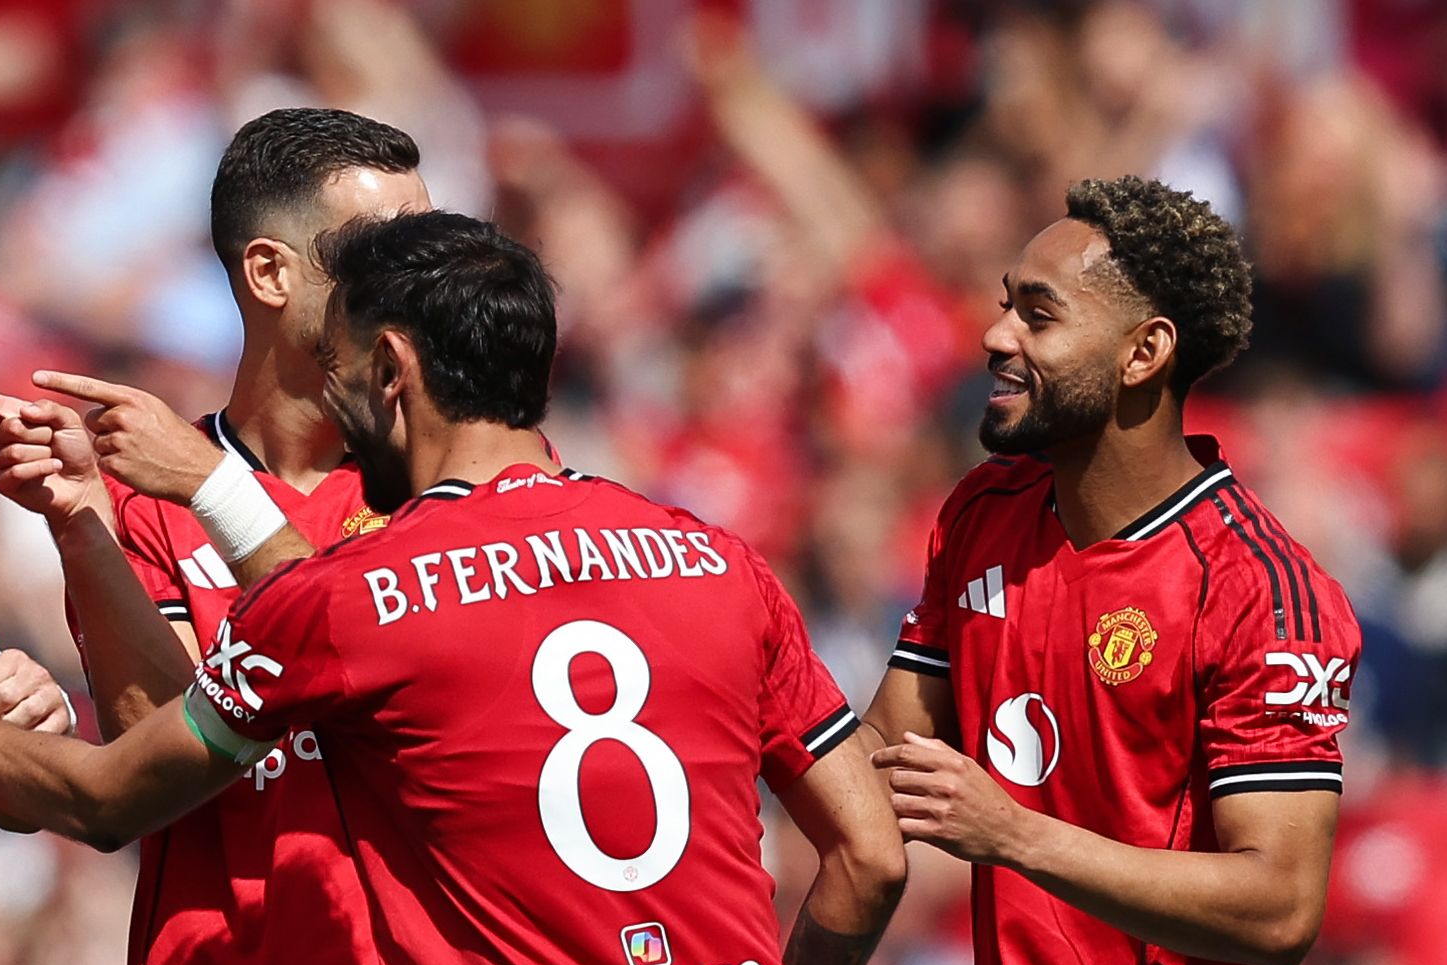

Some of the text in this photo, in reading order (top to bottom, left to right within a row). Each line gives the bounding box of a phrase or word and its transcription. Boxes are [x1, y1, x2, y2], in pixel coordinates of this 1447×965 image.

[363, 527, 728, 626] B.FERNANDES
[1101, 612, 1152, 647] MANCHESTER
[1094, 659, 1131, 681] UNITED
[531, 620, 691, 893] 8
